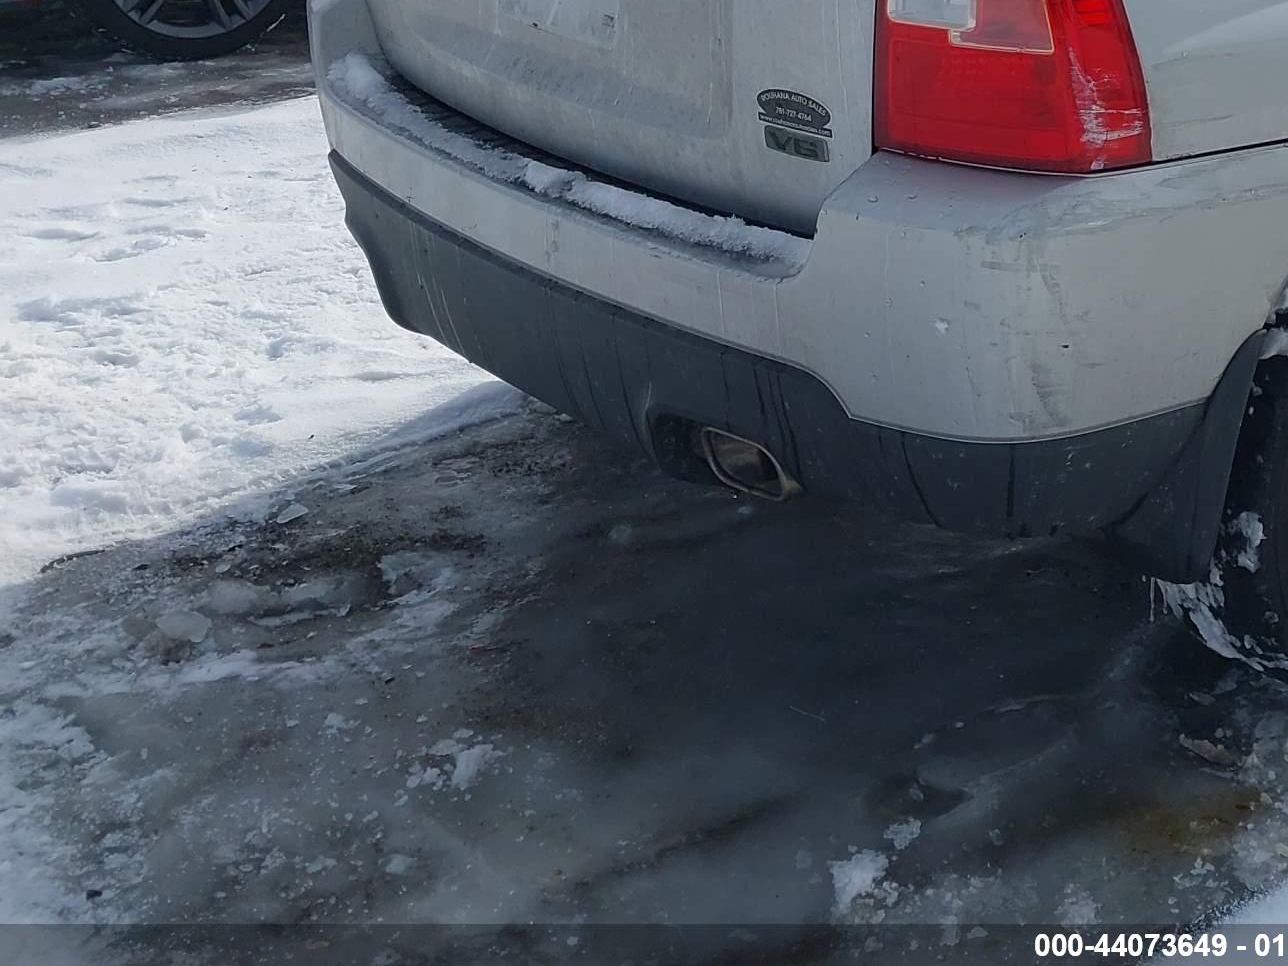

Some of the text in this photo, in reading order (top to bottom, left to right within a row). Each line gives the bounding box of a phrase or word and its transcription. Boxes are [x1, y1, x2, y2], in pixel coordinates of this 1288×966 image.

[791, 93, 807, 106] AUTO
[808, 100, 826, 116] SALES
[767, 130, 819, 159] V6
